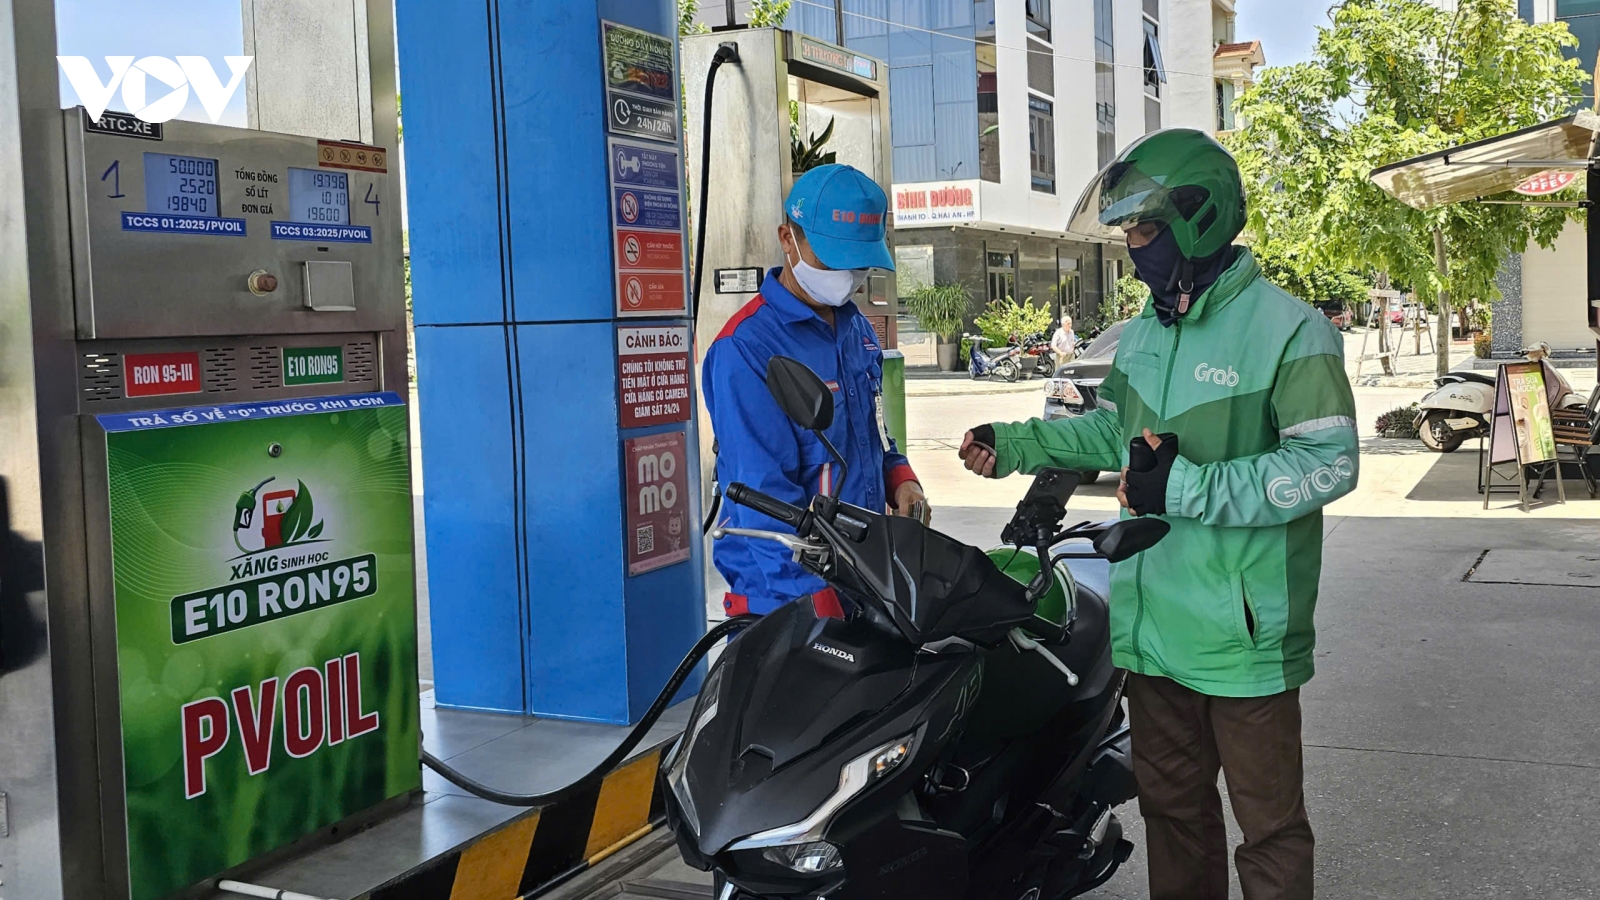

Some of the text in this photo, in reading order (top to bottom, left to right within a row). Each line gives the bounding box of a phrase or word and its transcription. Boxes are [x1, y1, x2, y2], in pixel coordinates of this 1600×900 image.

[97, 116, 152, 134] RTC-XE
[637, 116, 672, 133] 24h/24h
[170, 158, 213, 177] 50.000
[101, 160, 125, 198] 1
[180, 177, 214, 195] 2.520
[257, 170, 278, 184] ĐỒNG
[245, 185, 269, 199] SỐ LÍT
[364, 183, 380, 216] 4
[167, 195, 207, 212] 19840
[241, 203, 273, 215] ĐƠN GIÁ
[308, 206, 340, 222] 19600
[832, 208, 856, 223] E10
[126, 216, 242, 232] TCCS 01:2025/PVOIL
[275, 225, 368, 239] TCCS 03:2025/PVOIL
[626, 330, 682, 348] CẢNH BÁO:
[134, 363, 193, 385] RON 95-III
[288, 354, 338, 377] E10 RON95
[622, 360, 643, 374] CHÚNG
[644, 359, 653, 373] TÔI
[655, 358, 675, 372] KHÔNG
[1194, 362, 1240, 387] Grab
[655, 387, 664, 401] CÓ
[664, 387, 688, 400] CAMERA
[128, 412, 166, 428] TRẢ
[173, 408, 198, 424] SỐ
[200, 405, 226, 420] VỀ
[260, 401, 317, 415] TRƯỚC
[319, 399, 348, 411] KHI
[349, 395, 385, 408] BƠM
[634, 402, 680, 418] GIÁM SÁT 24/24
[1266, 455, 1353, 509] Grab
[229, 551, 329, 581] XĂNG SINH HỌC
[184, 560, 371, 636] E10 RON95
[812, 642, 855, 663] HONDA
[181, 652, 379, 799] PVOIL
